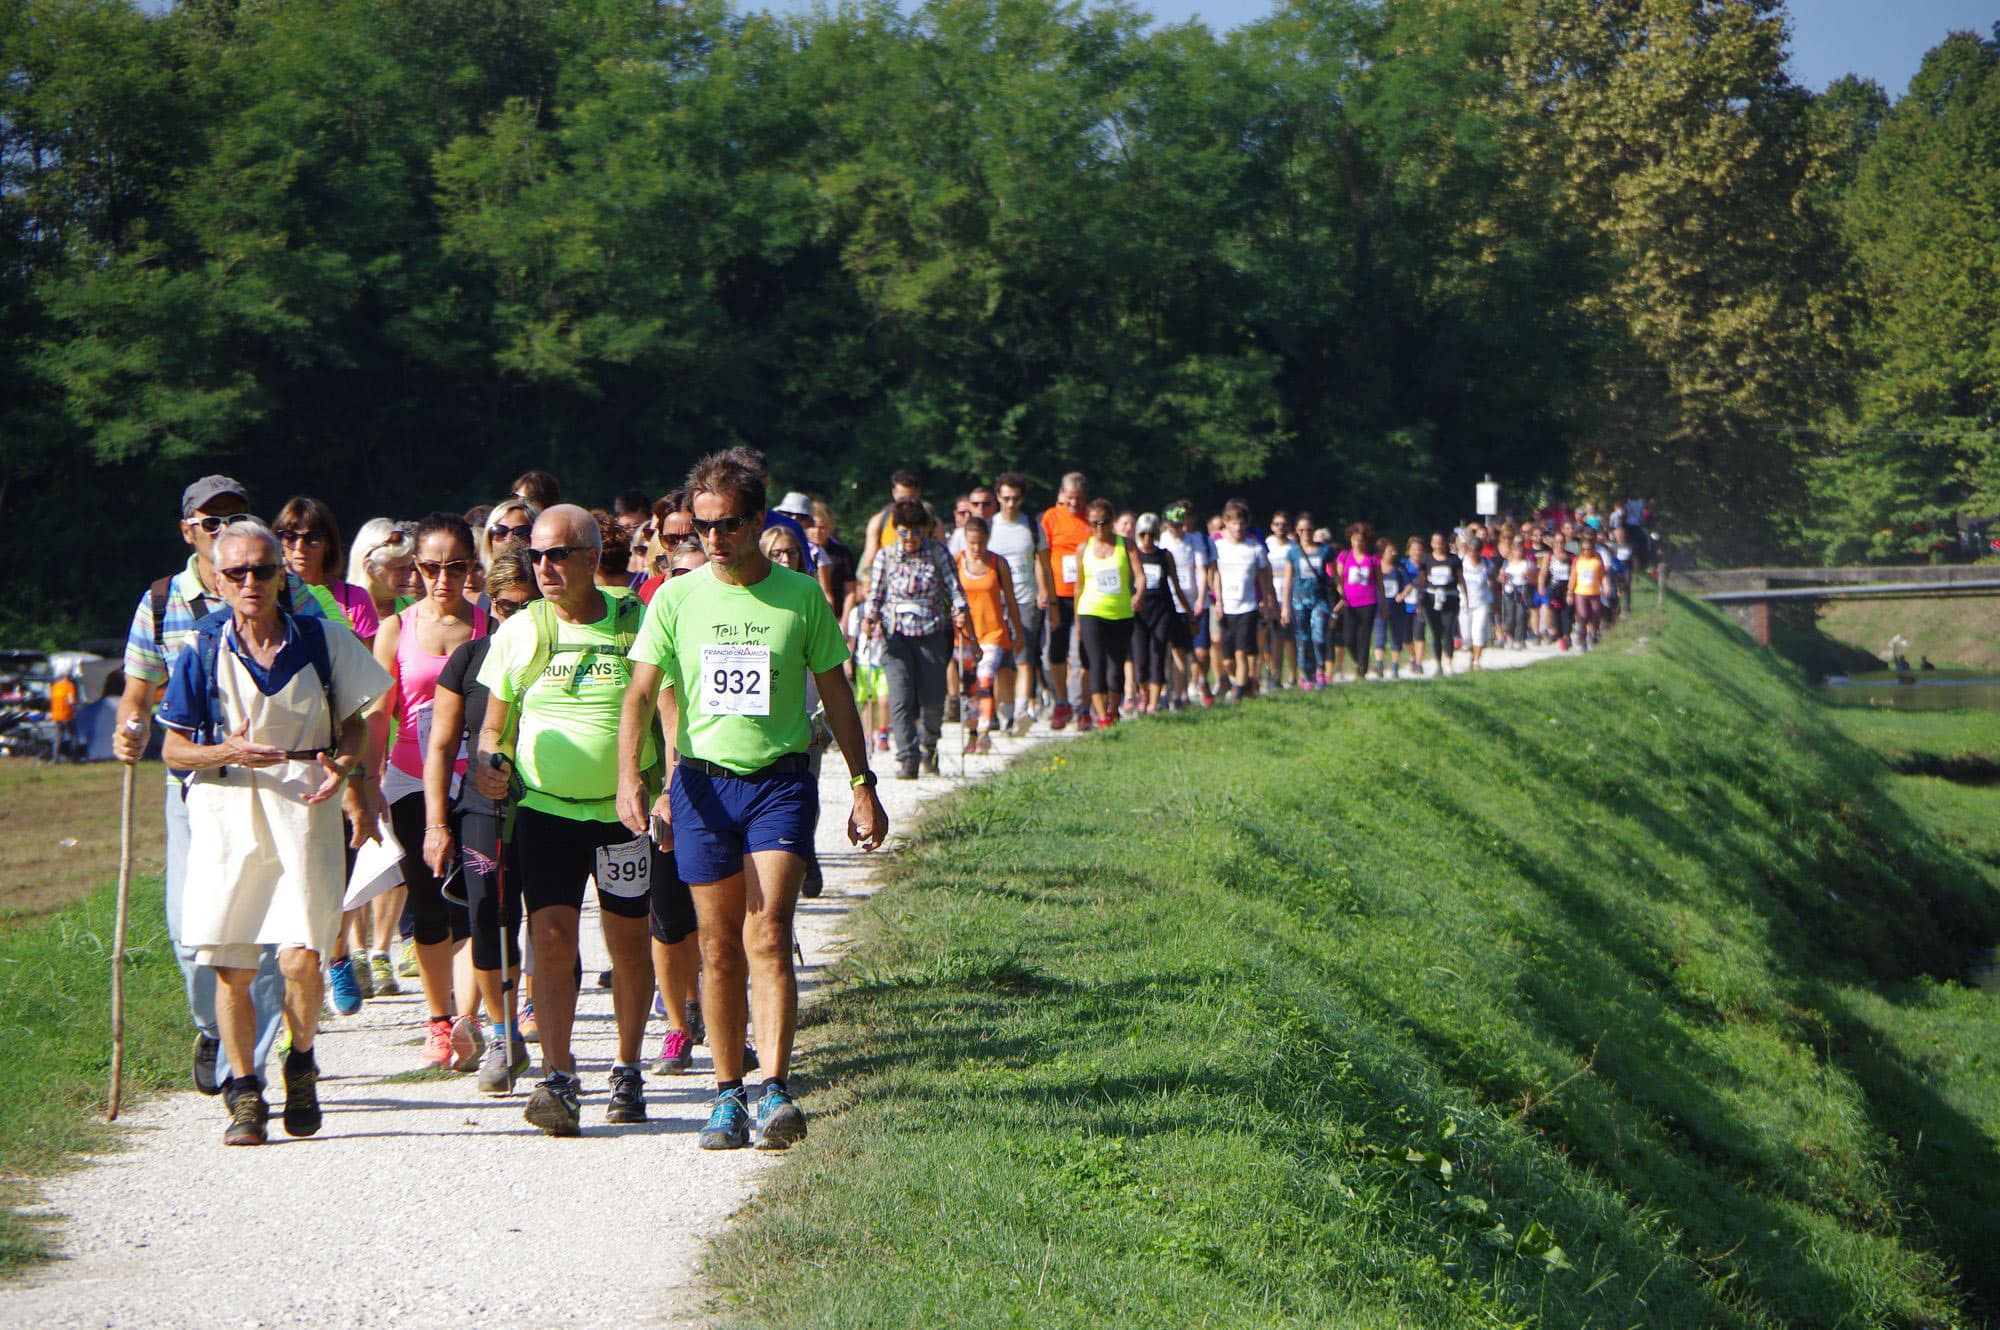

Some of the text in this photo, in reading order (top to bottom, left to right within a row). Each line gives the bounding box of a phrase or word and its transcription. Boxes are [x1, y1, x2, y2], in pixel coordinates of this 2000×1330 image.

[712, 622, 770, 638] Tell Your
[713, 669, 761, 695] 932
[607, 856, 648, 882] 399
